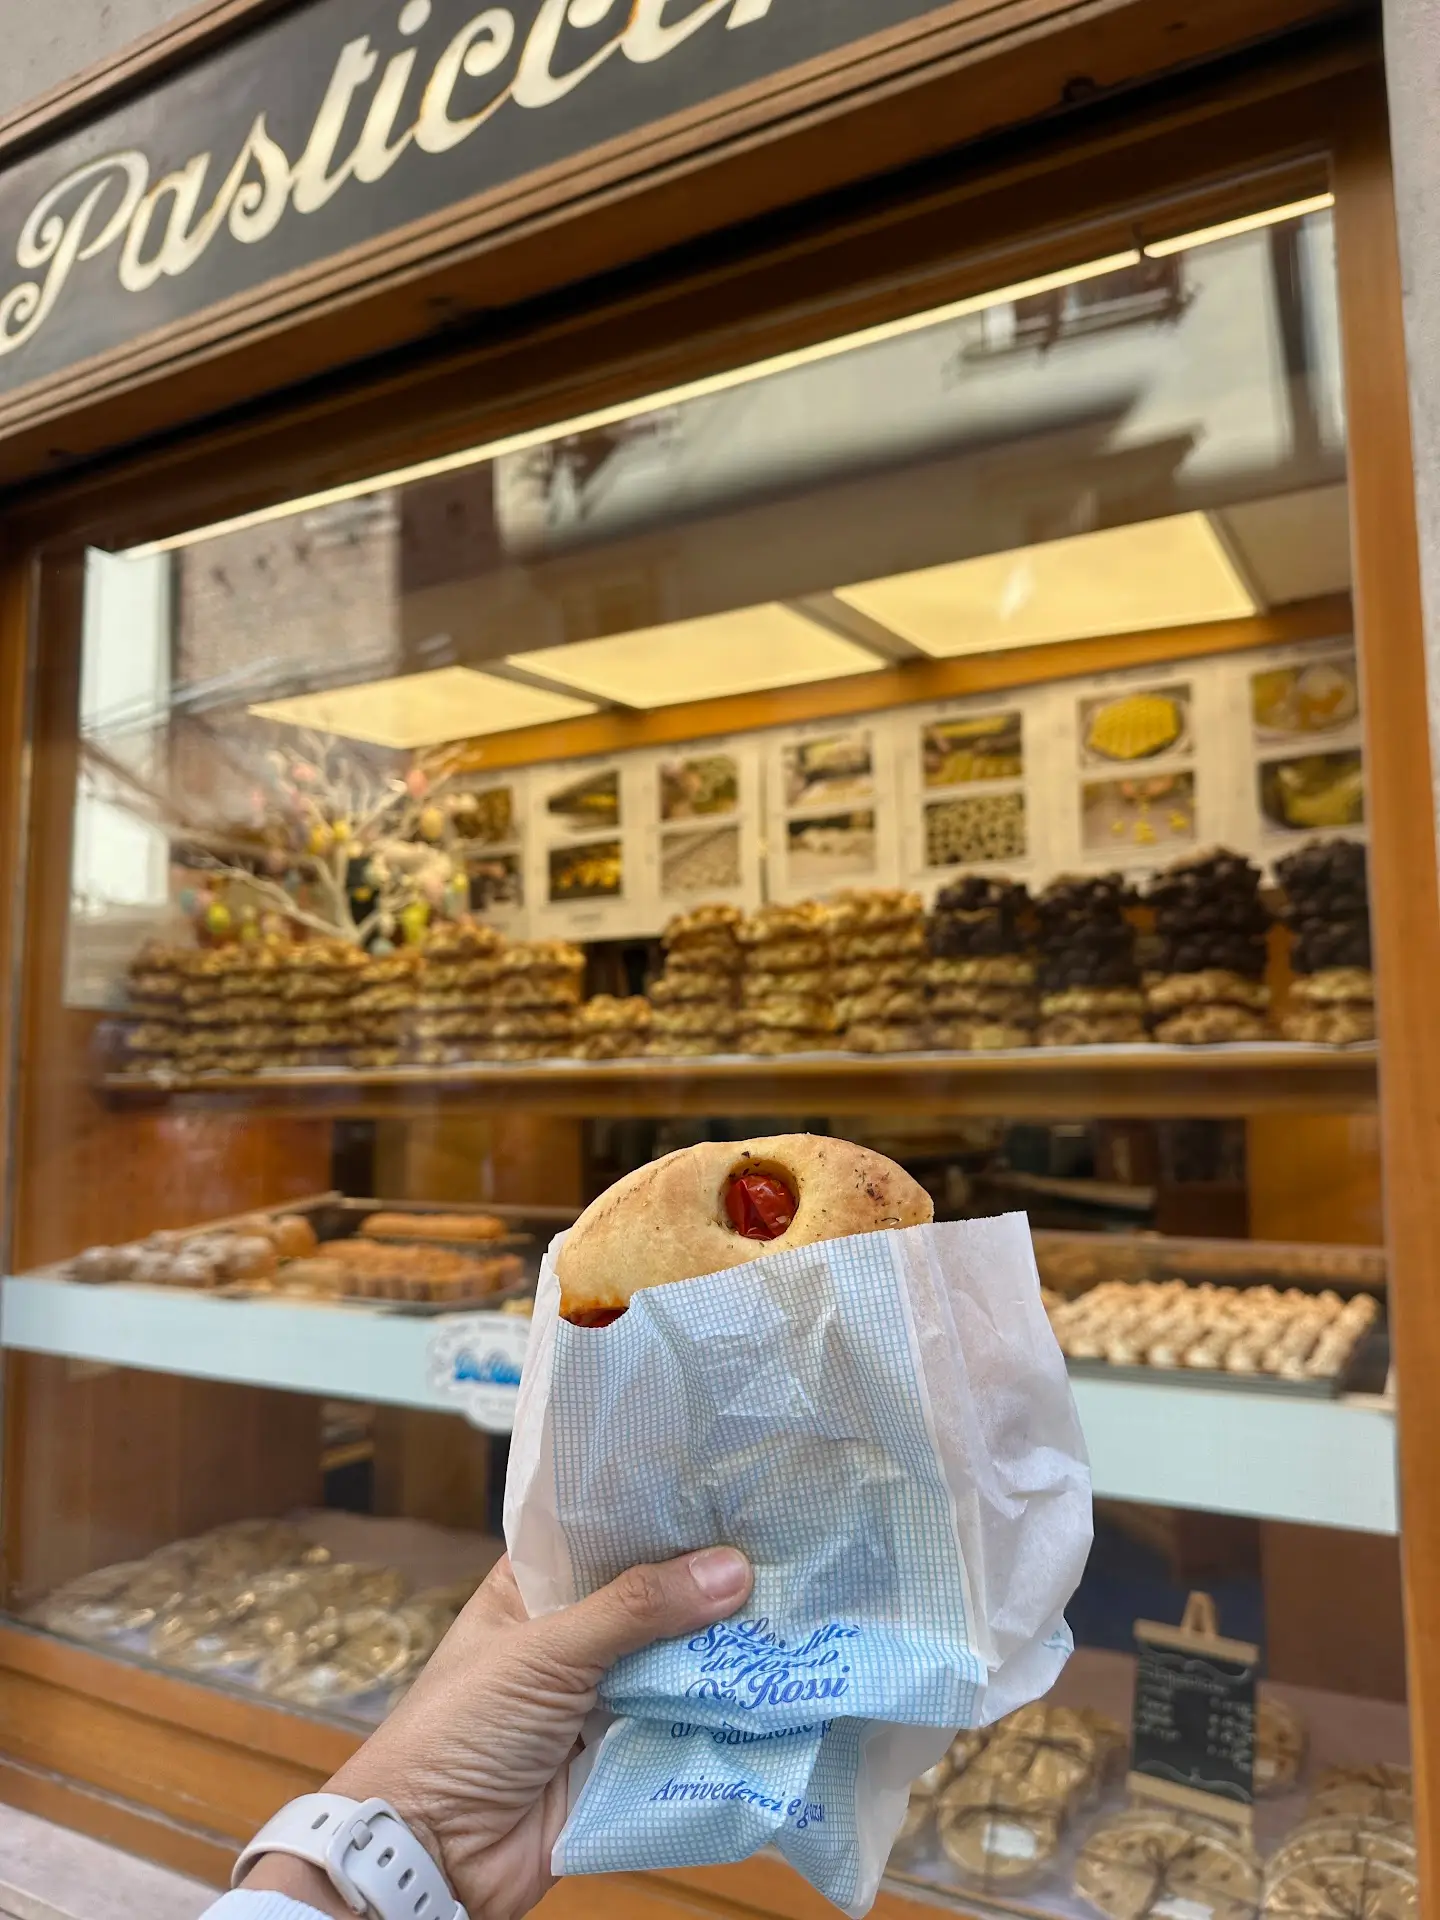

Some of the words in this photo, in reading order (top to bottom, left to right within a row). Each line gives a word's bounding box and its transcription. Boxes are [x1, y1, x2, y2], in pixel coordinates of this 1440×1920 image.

[0, 0, 775, 355] Pasticc
[738, 1665, 851, 1711] Rossi
[650, 1775, 786, 1812] Arrivederci
[787, 1798, 802, 1816] e
